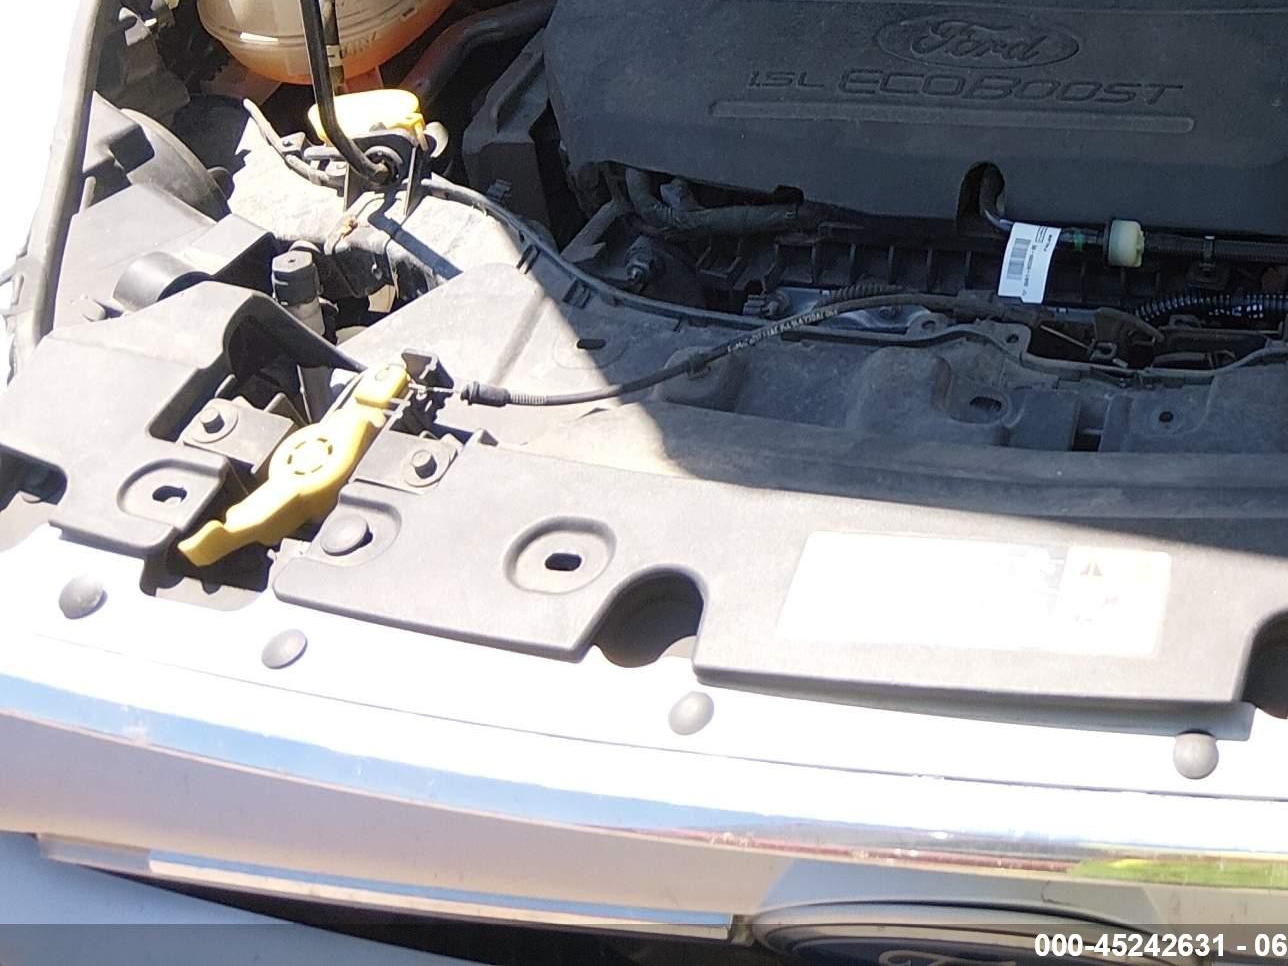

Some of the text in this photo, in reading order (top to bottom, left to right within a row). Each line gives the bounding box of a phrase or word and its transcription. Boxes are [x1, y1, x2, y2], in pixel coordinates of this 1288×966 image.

[910, 19, 1050, 62] Ford
[747, 67, 1185, 106] 1.5L ECOBOOST
